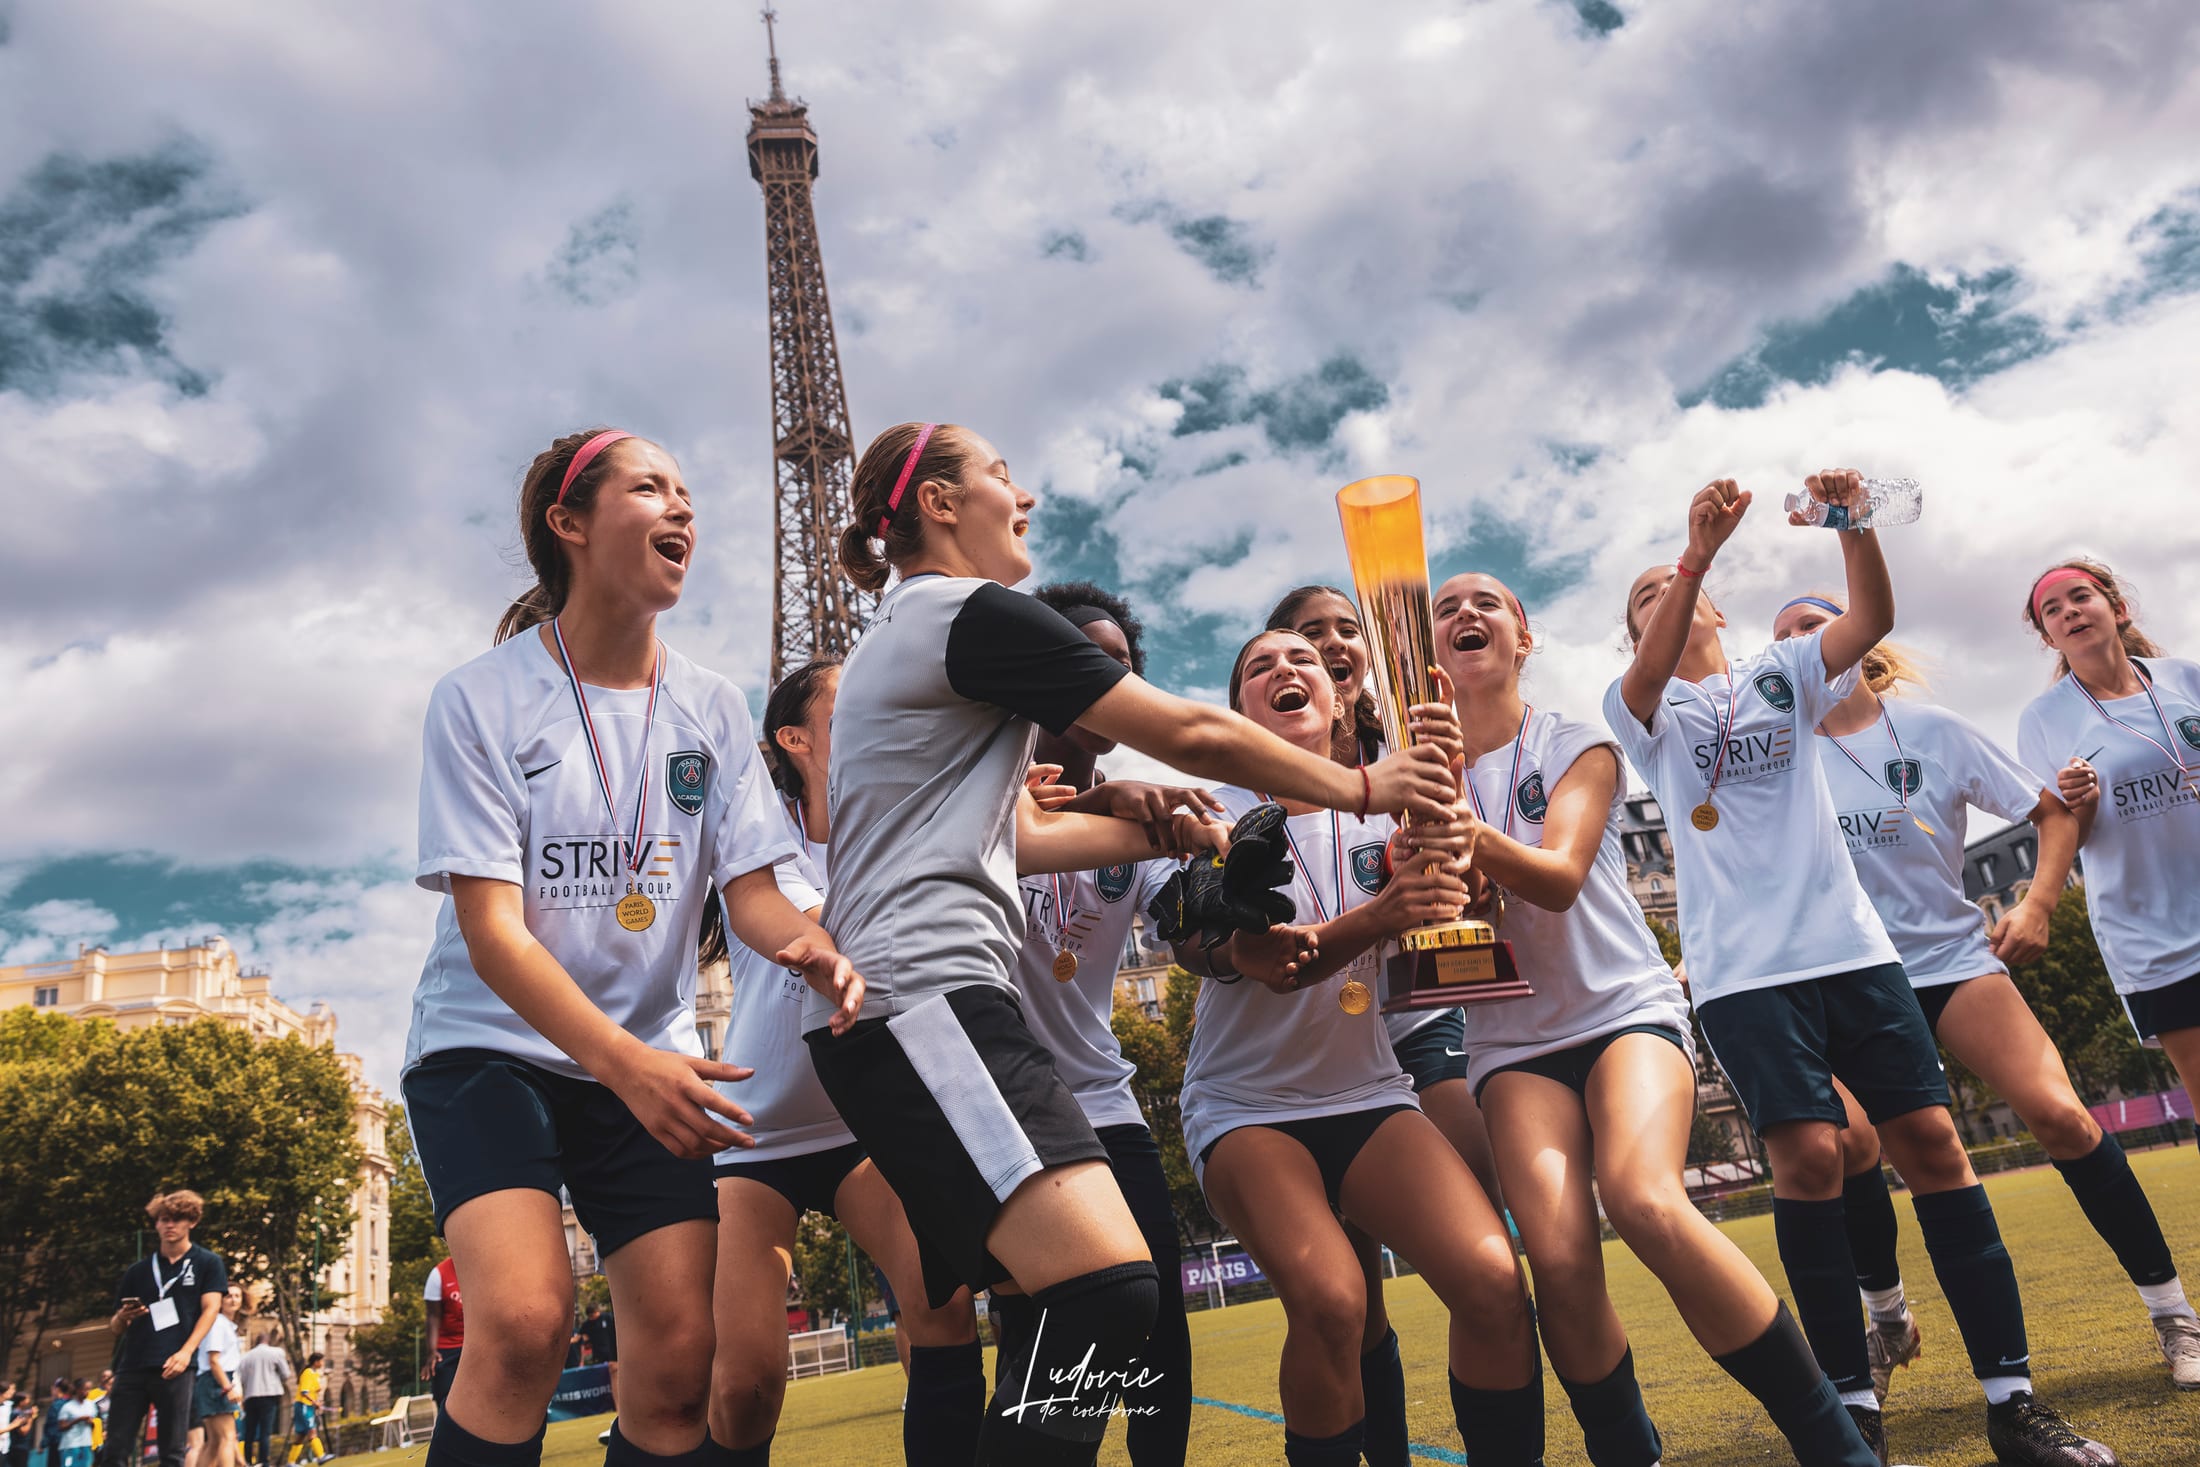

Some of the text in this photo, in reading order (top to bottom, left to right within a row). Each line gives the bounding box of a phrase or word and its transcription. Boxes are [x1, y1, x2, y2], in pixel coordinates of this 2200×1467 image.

[1760, 758, 1792, 773] GROUP
[2118, 790, 2200, 818] FOOTBALL GROU
[1838, 809, 1905, 837] RIVE
[1867, 835, 1901, 846] GROUP
[540, 840, 681, 880] STRIVE
[540, 882, 672, 899] FOOTBALL GROUP
[621, 908, 649, 917] WORLD
[624, 901, 645, 909] PARIS
[624, 916, 649, 925] GAMES
[1345, 954, 1373, 970] OUP
[783, 979, 807, 994] FOO
[1187, 1261, 1247, 1286] PARIS
